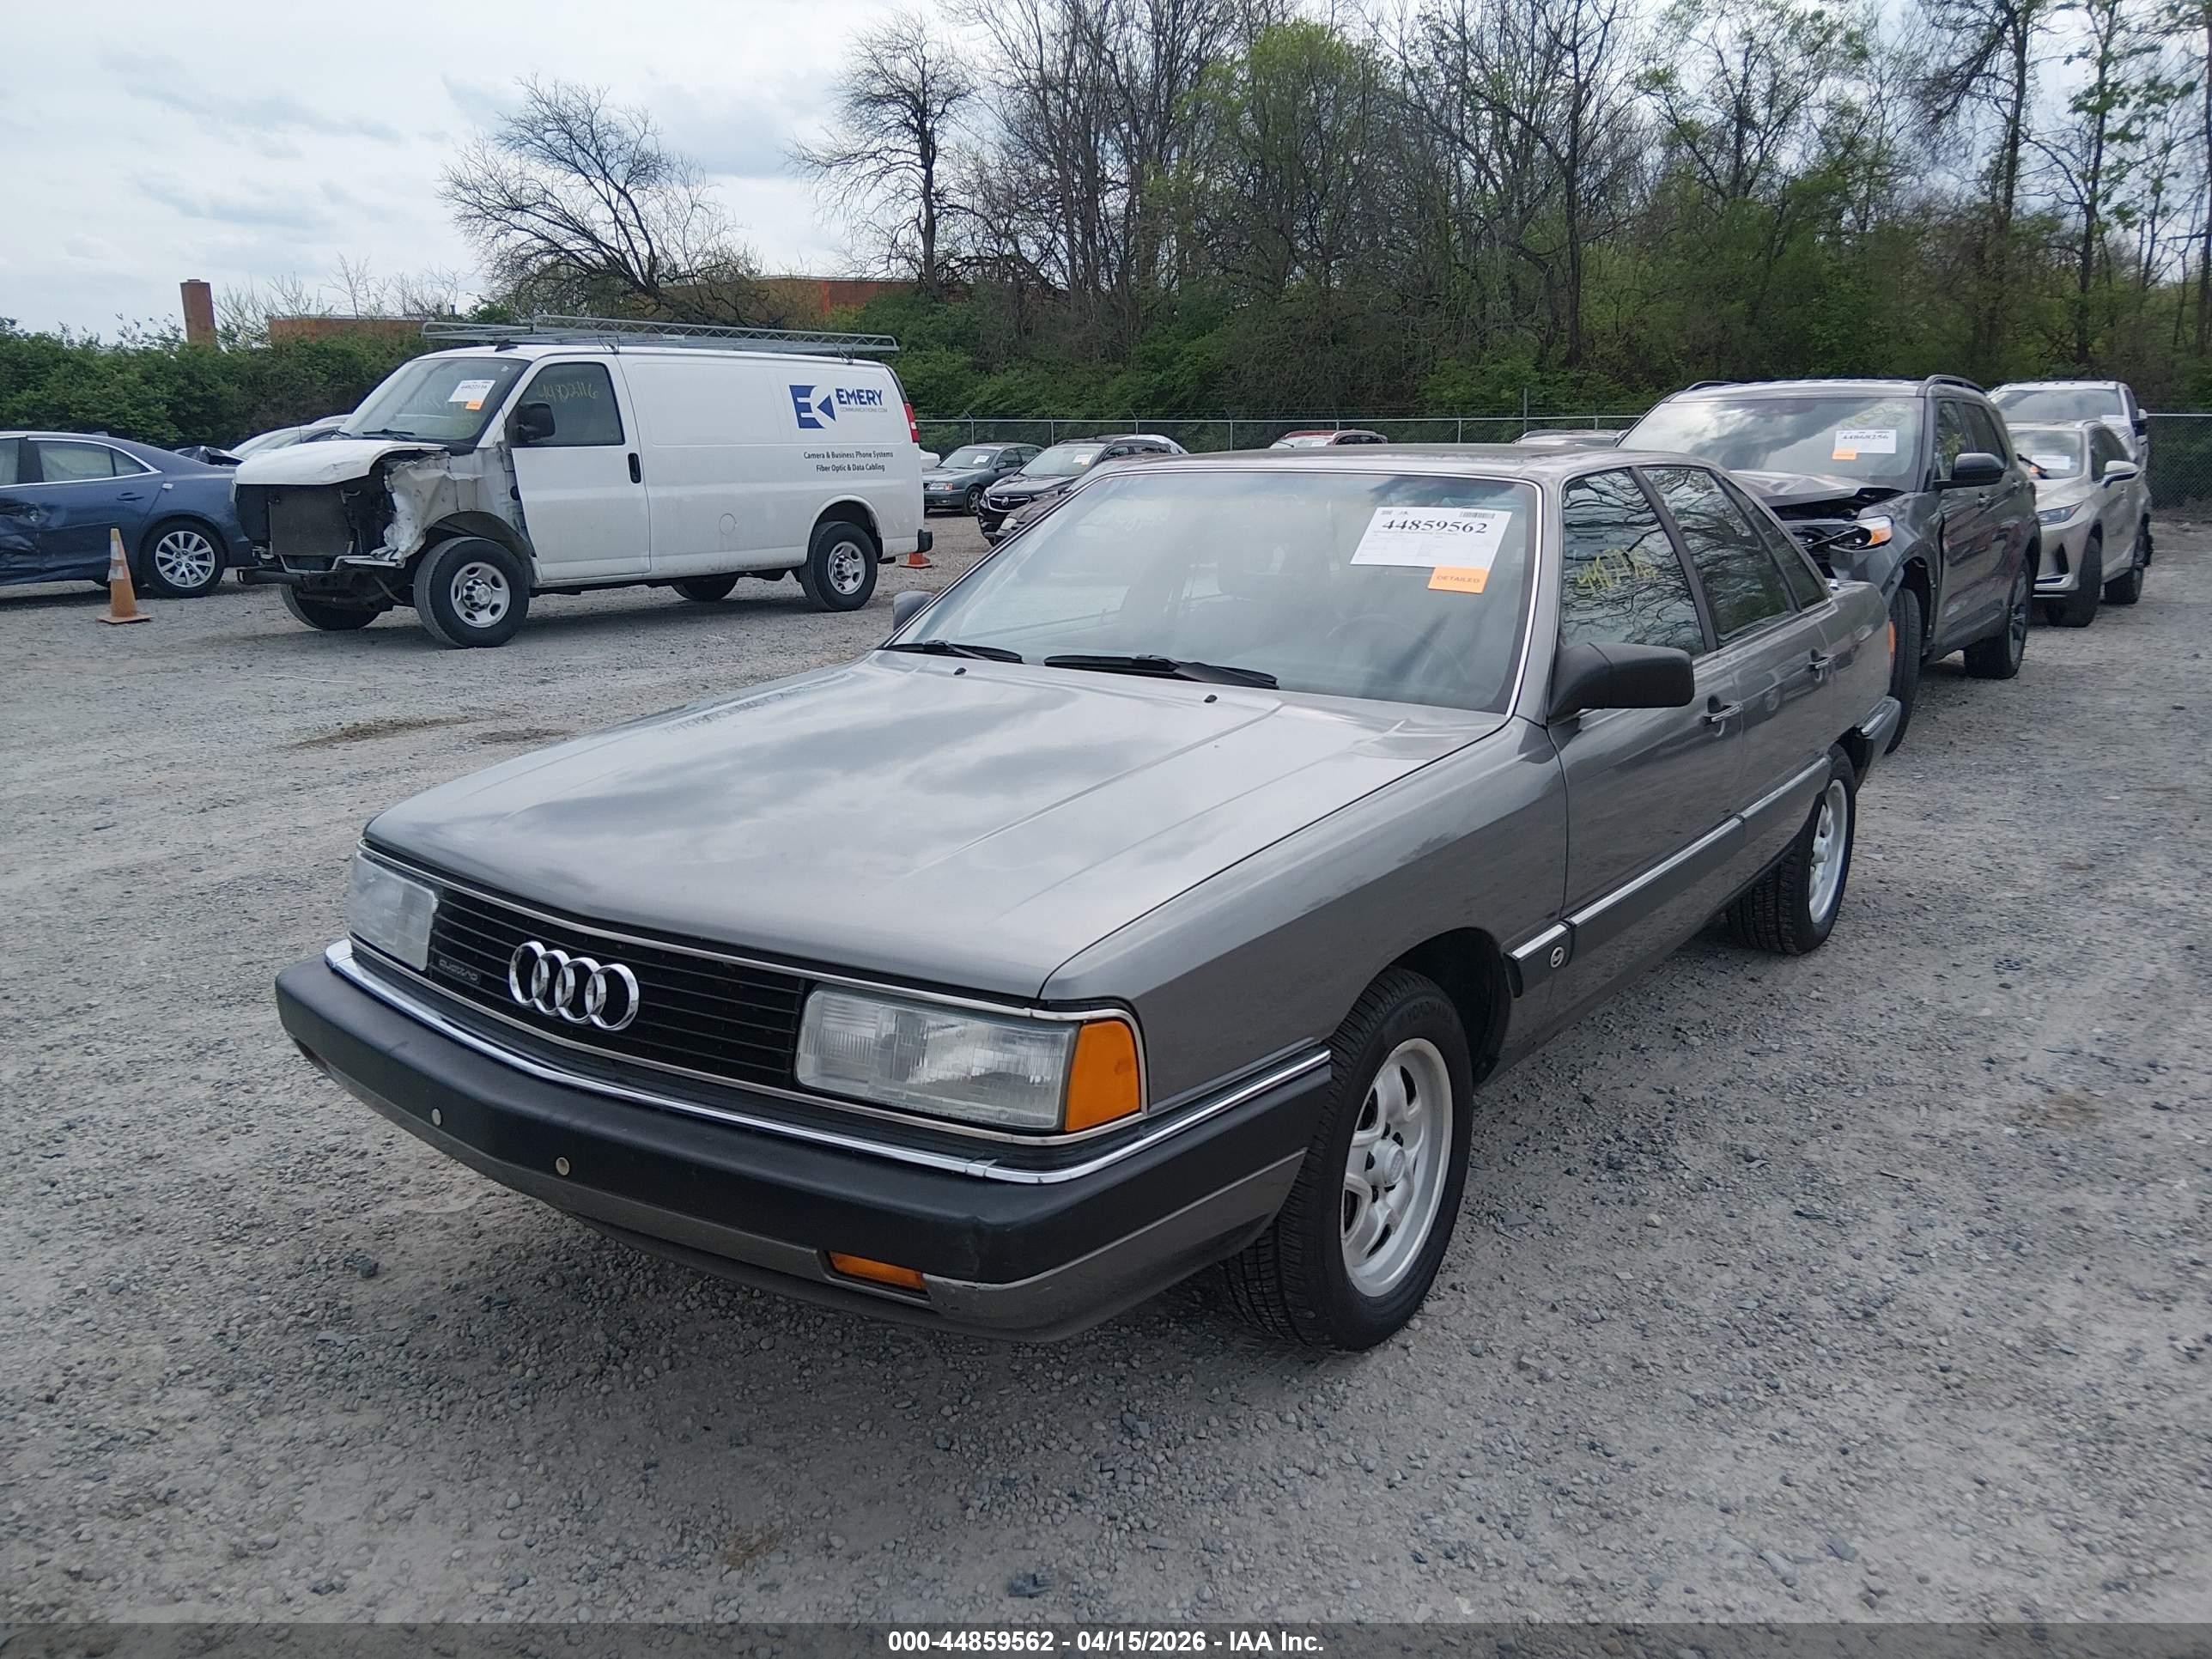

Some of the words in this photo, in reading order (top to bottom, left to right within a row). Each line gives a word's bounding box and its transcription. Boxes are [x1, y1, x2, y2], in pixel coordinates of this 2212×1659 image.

[836, 388, 883, 406] EMERY
[804, 451, 825, 459] Camera
[831, 451, 854, 459] Business
[873, 451, 894, 459] Systems
[831, 465, 847, 473] Optic
[866, 463, 885, 472] Cabling
[1382, 520, 1487, 534] 44859562
[1437, 575, 1480, 584] DETAILED
